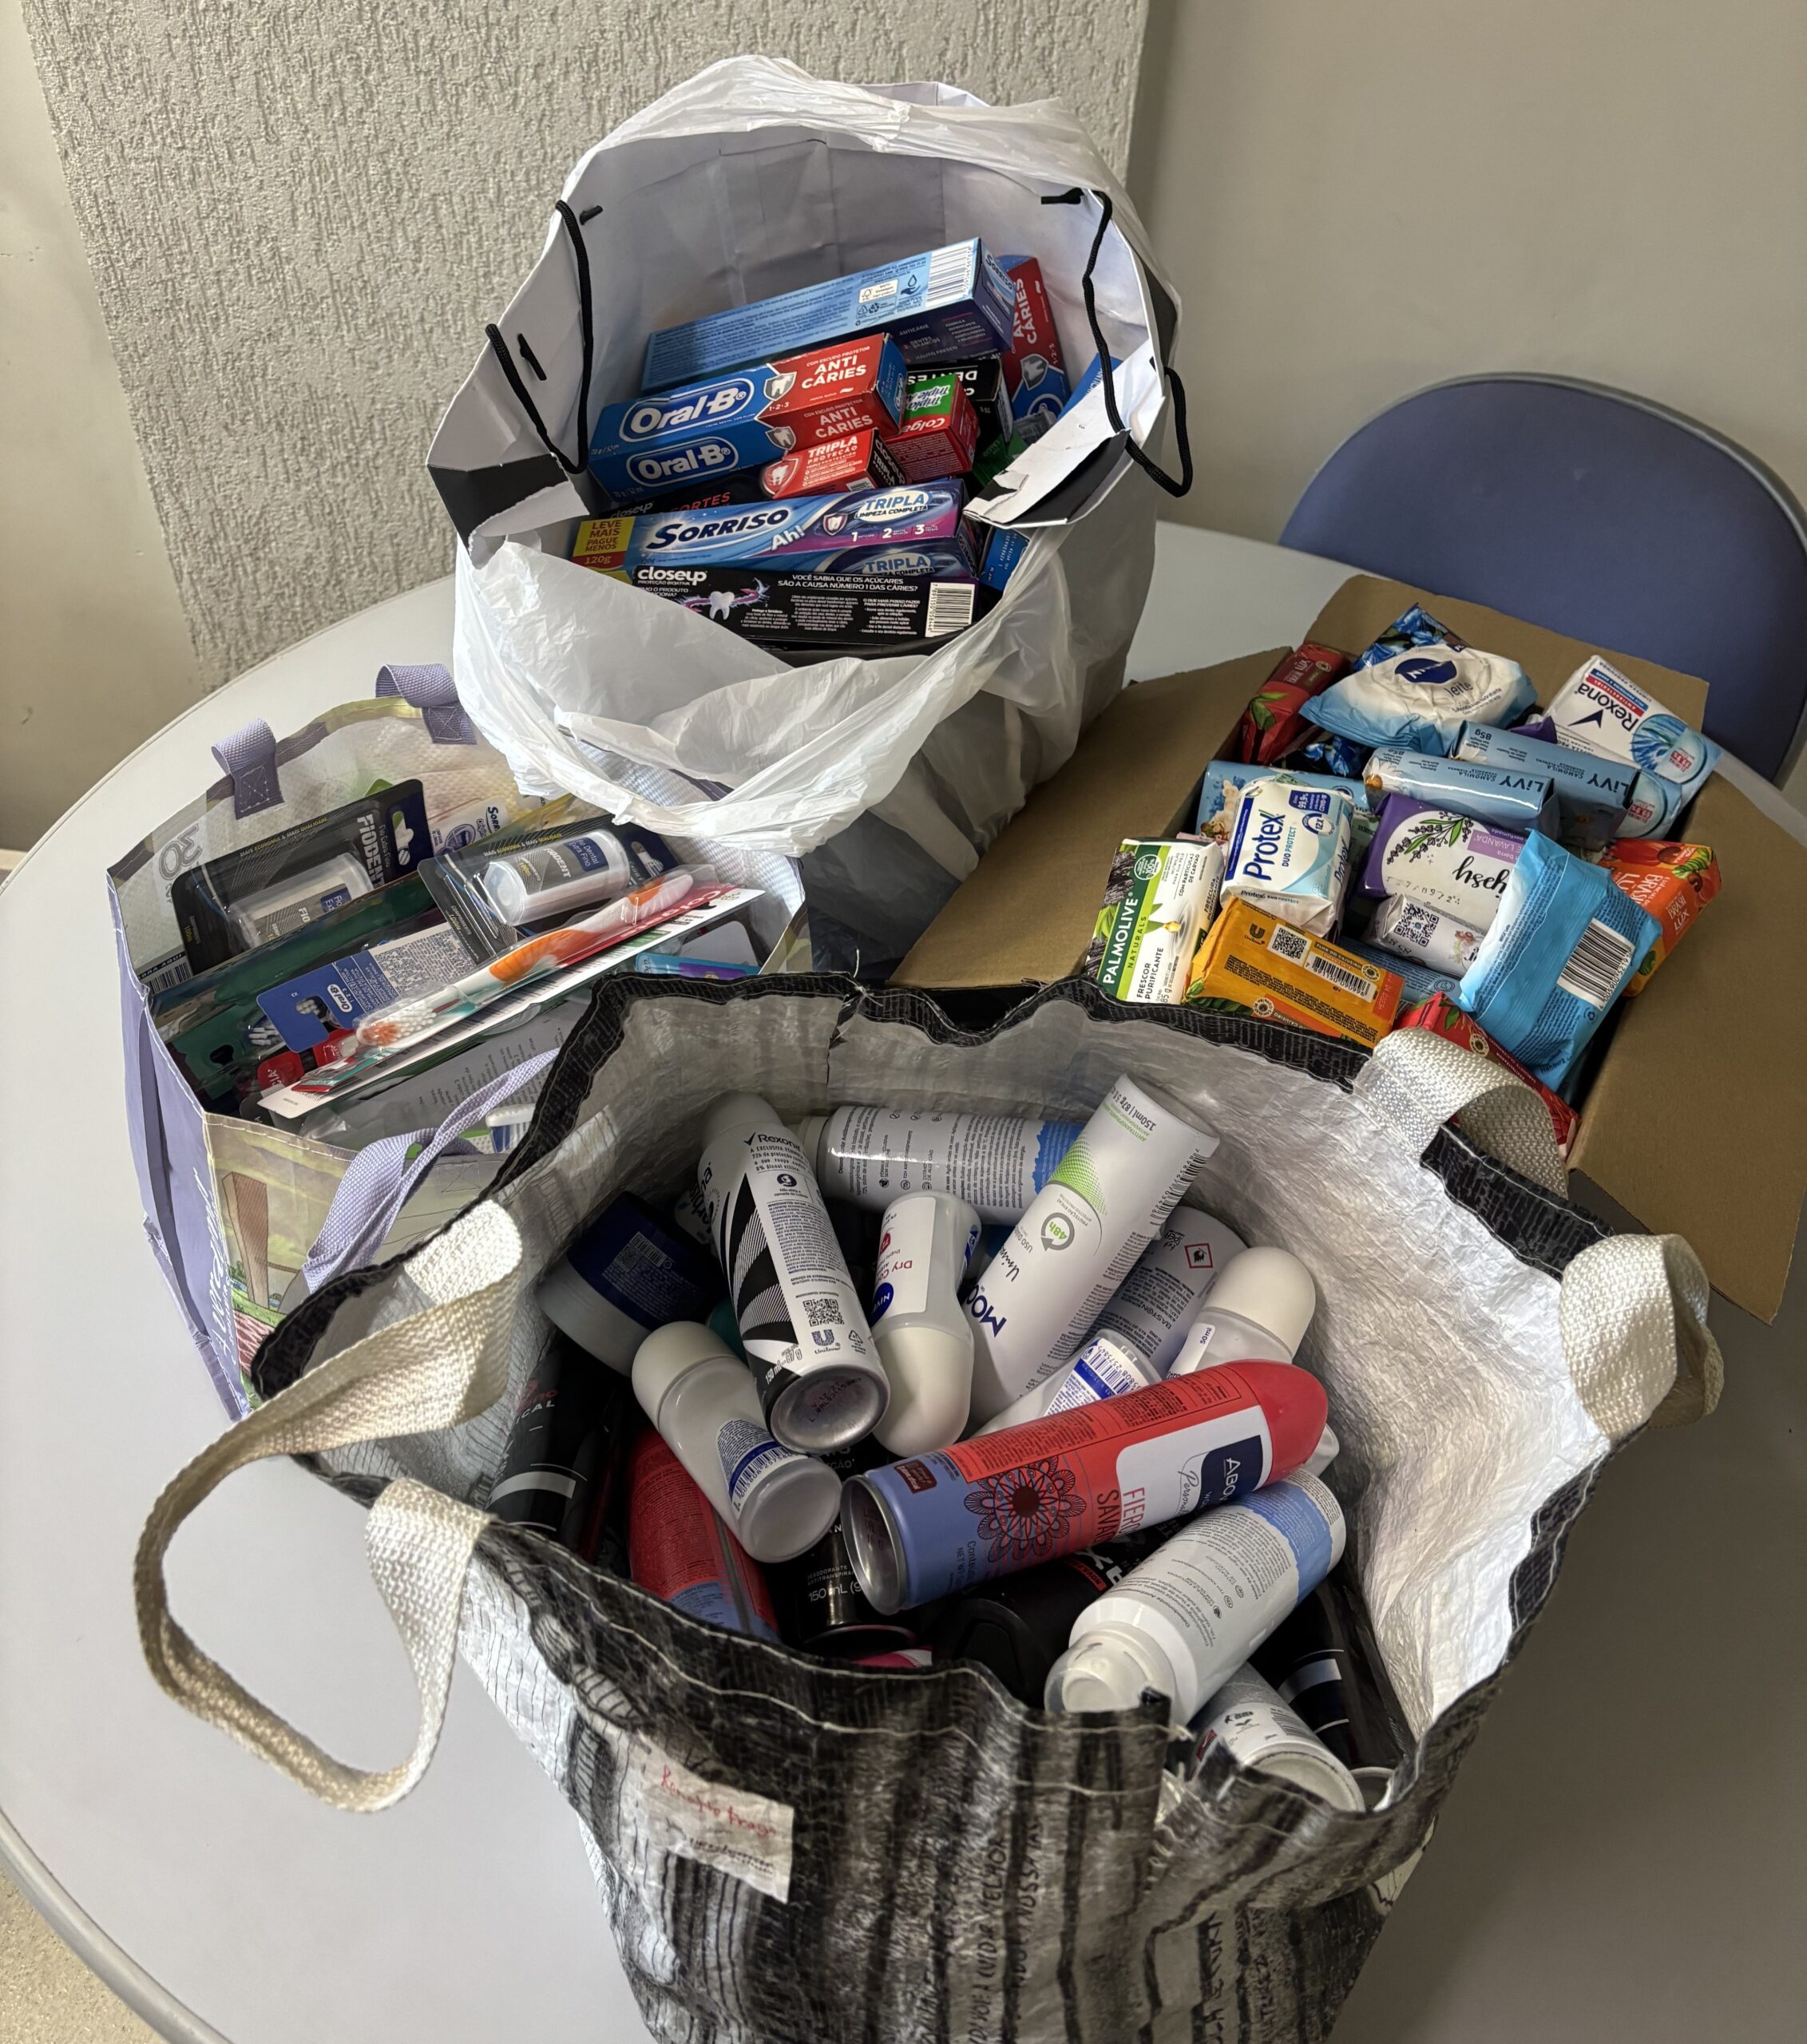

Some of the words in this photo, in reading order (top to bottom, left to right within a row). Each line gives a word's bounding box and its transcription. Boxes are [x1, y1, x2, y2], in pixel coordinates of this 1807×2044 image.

[1016, 279, 1037, 344] CÁRIES
[814, 355, 858, 375] ANTI
[801, 365, 867, 389] CÁRIES
[630, 387, 739, 434] Oral-B
[819, 406, 858, 426] ANTI
[815, 414, 874, 438] CARIES
[808, 436, 858, 458] TRIPLA
[638, 444, 724, 479] Oral-B
[855, 509, 888, 518] LIMPEZA
[889, 505, 928, 516] COMPLETA
[865, 494, 927, 510] TRIPLA
[589, 528, 620, 537] MAIS
[591, 519, 624, 529] LEVE
[645, 509, 790, 549] SORRISO
[851, 532, 858, 542] 1
[882, 528, 893, 539] 2
[914, 524, 925, 535] 3
[587, 537, 619, 546] PAGUE
[771, 525, 806, 551] Ah!
[585, 544, 617, 553] MENOS
[584, 556, 612, 565] 120g
[865, 557, 928, 572] TRIPLA
[637, 566, 707, 585] closeup
[829, 581, 864, 590] NÚMERO
[1447, 679, 1473, 698] leite
[1578, 683, 1639, 731] Rexona
[1475, 728, 1492, 741] 85g
[1242, 813, 1286, 881] Protex
[1285, 826, 1297, 853] PROTECT
[1476, 834, 1514, 850] LAVANDA
[578, 853, 591, 869] Fino
[584, 846, 600, 866] Dental
[1282, 853, 1291, 867] DUO
[1203, 878, 1216, 913] FRESCURA
[1102, 898, 1139, 984] PALMOLIVE
[1127, 916, 1147, 969] NATURALS
[1136, 962, 1151, 998] FRESCOR
[1144, 947, 1164, 1000] PURIFICANTE
[330, 984, 351, 1011] Oral-B
[1135, 1107, 1158, 1132] 150ml
[1048, 1221, 1068, 1240] 48h
[1019, 1238, 1033, 1254] USO
[891, 1260, 913, 1274] Dry
[1140, 1303, 1173, 1329] BASTON
[808, 1588, 827, 1602] 150
